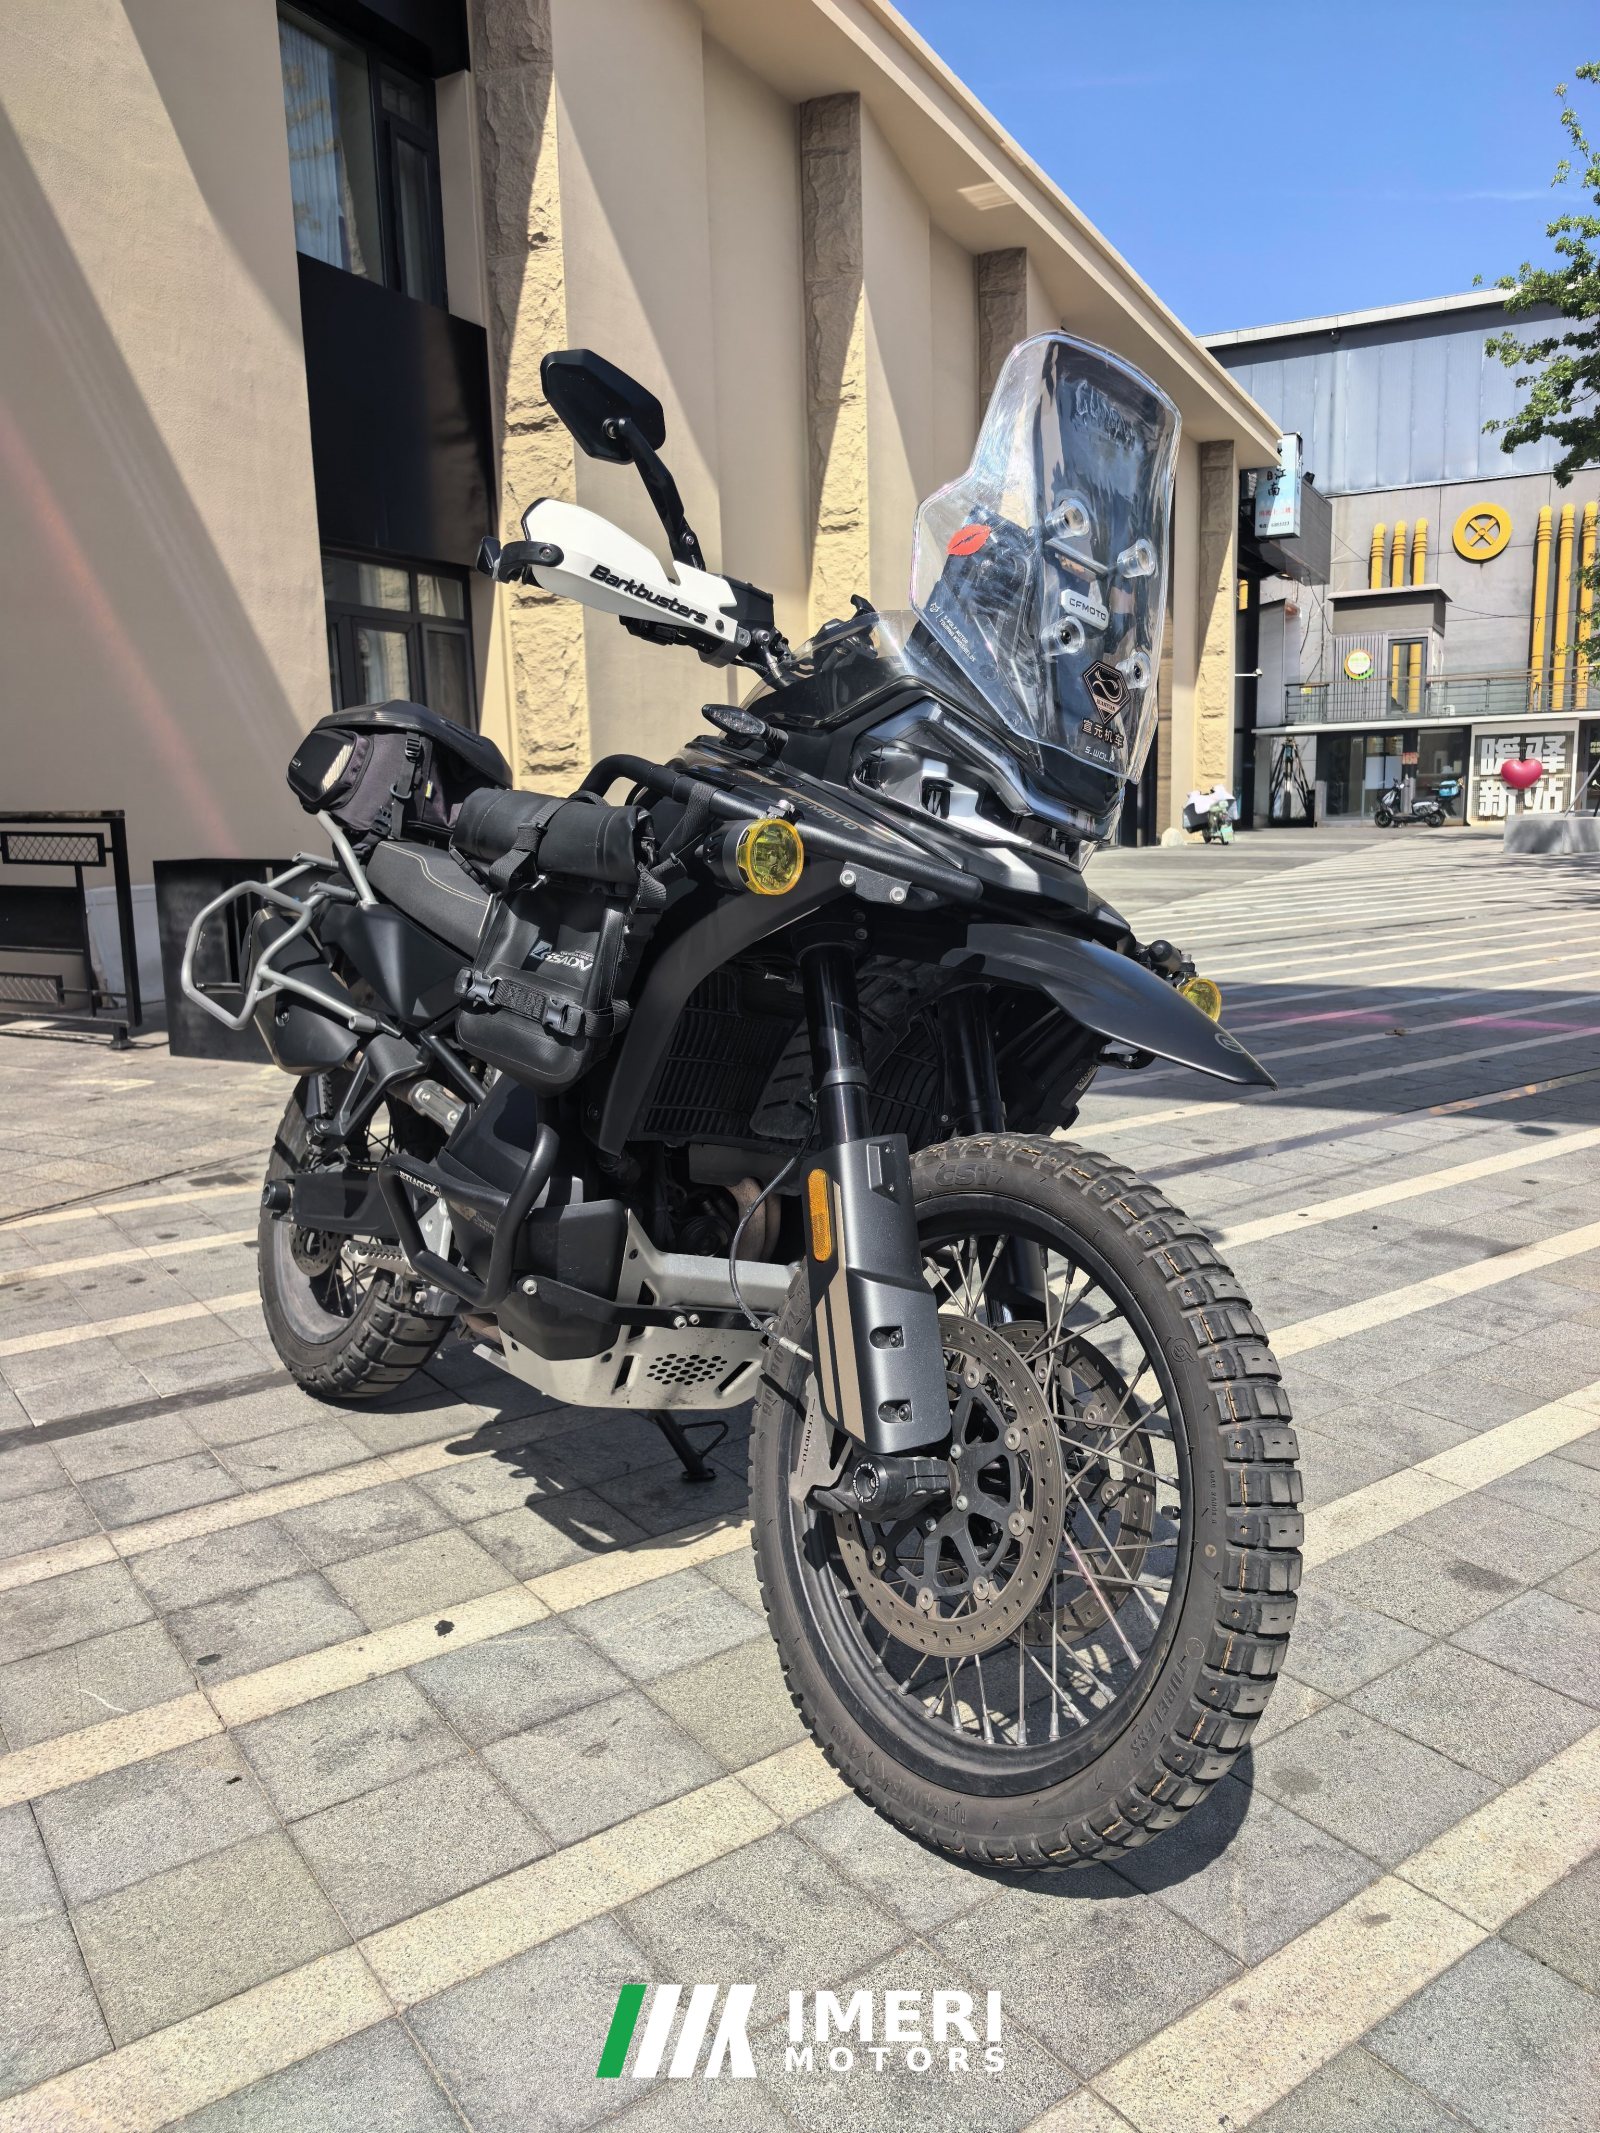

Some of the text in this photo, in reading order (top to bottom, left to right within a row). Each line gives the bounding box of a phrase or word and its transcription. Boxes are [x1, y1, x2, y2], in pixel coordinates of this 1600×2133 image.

[590, 564, 708, 625] Barkbusters
[1069, 598, 1107, 621] CFMOTO
[1083, 719, 1124, 748] 宣元机车
[787, 794, 859, 830] CFMOTO
